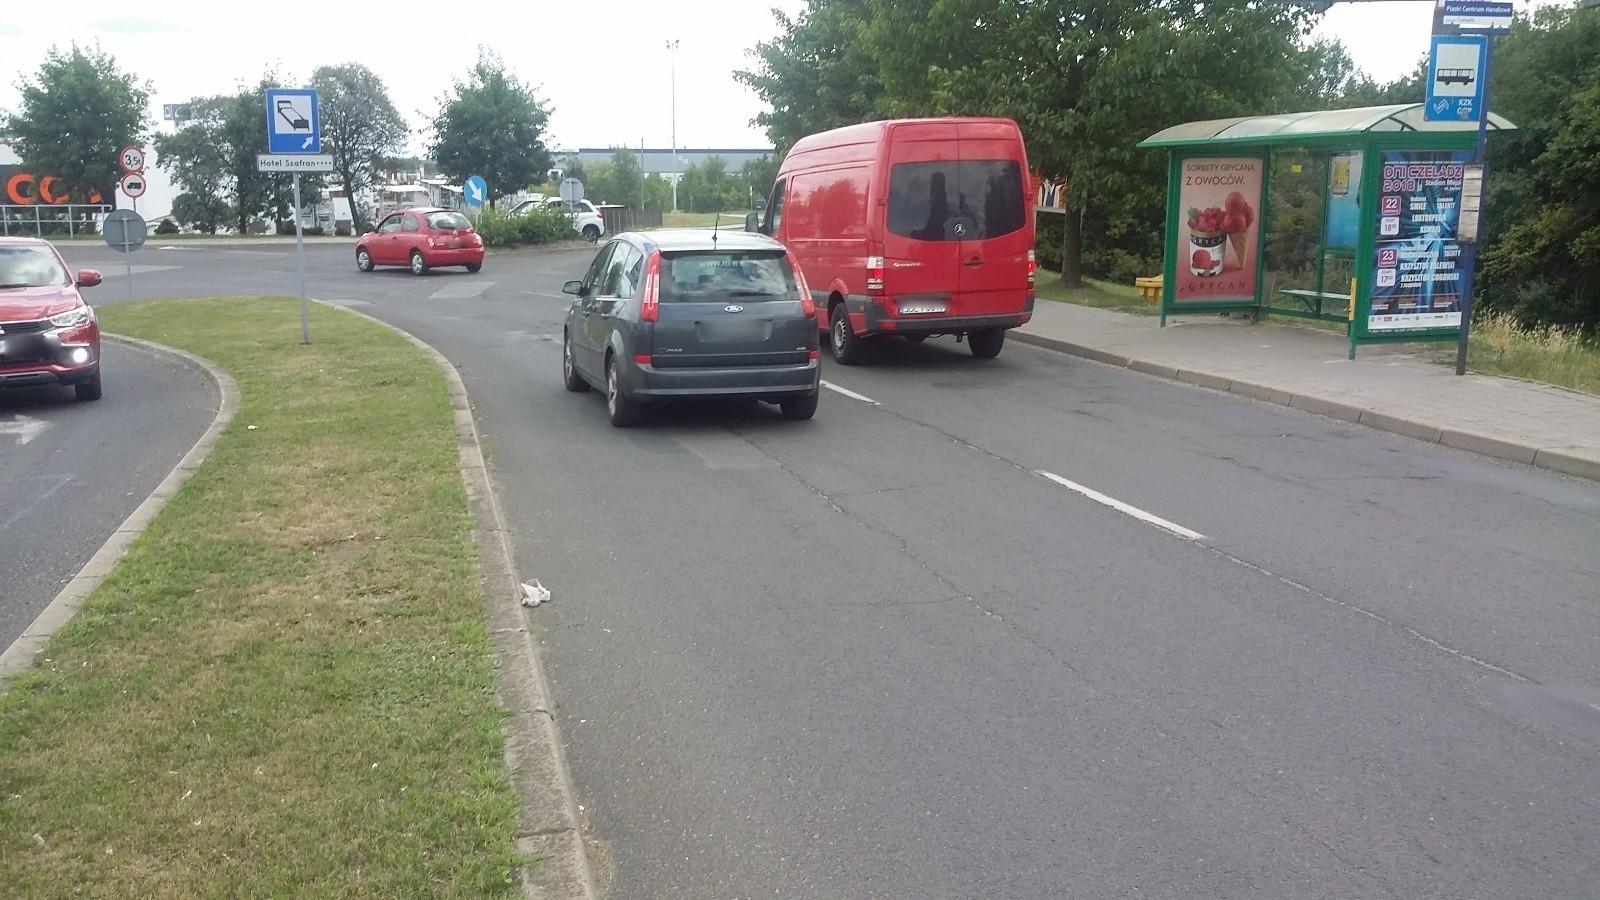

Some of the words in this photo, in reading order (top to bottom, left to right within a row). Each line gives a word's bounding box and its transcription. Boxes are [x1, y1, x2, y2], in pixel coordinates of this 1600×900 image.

[1458, 98, 1473, 106] KZK
[260, 159, 282, 167] Hotel
[285, 159, 316, 167] Szafran
[1186, 163, 1219, 171] SORBETY
[1220, 163, 1255, 171] GRYCANA
[1408, 164, 1463, 179] CZELADZ
[1185, 176, 1192, 185] Z
[1194, 173, 1245, 186] OWOCÓW.
[1383, 180, 1415, 193] 2018
[1385, 198, 1398, 209] 22
[1382, 250, 1394, 261] 23
